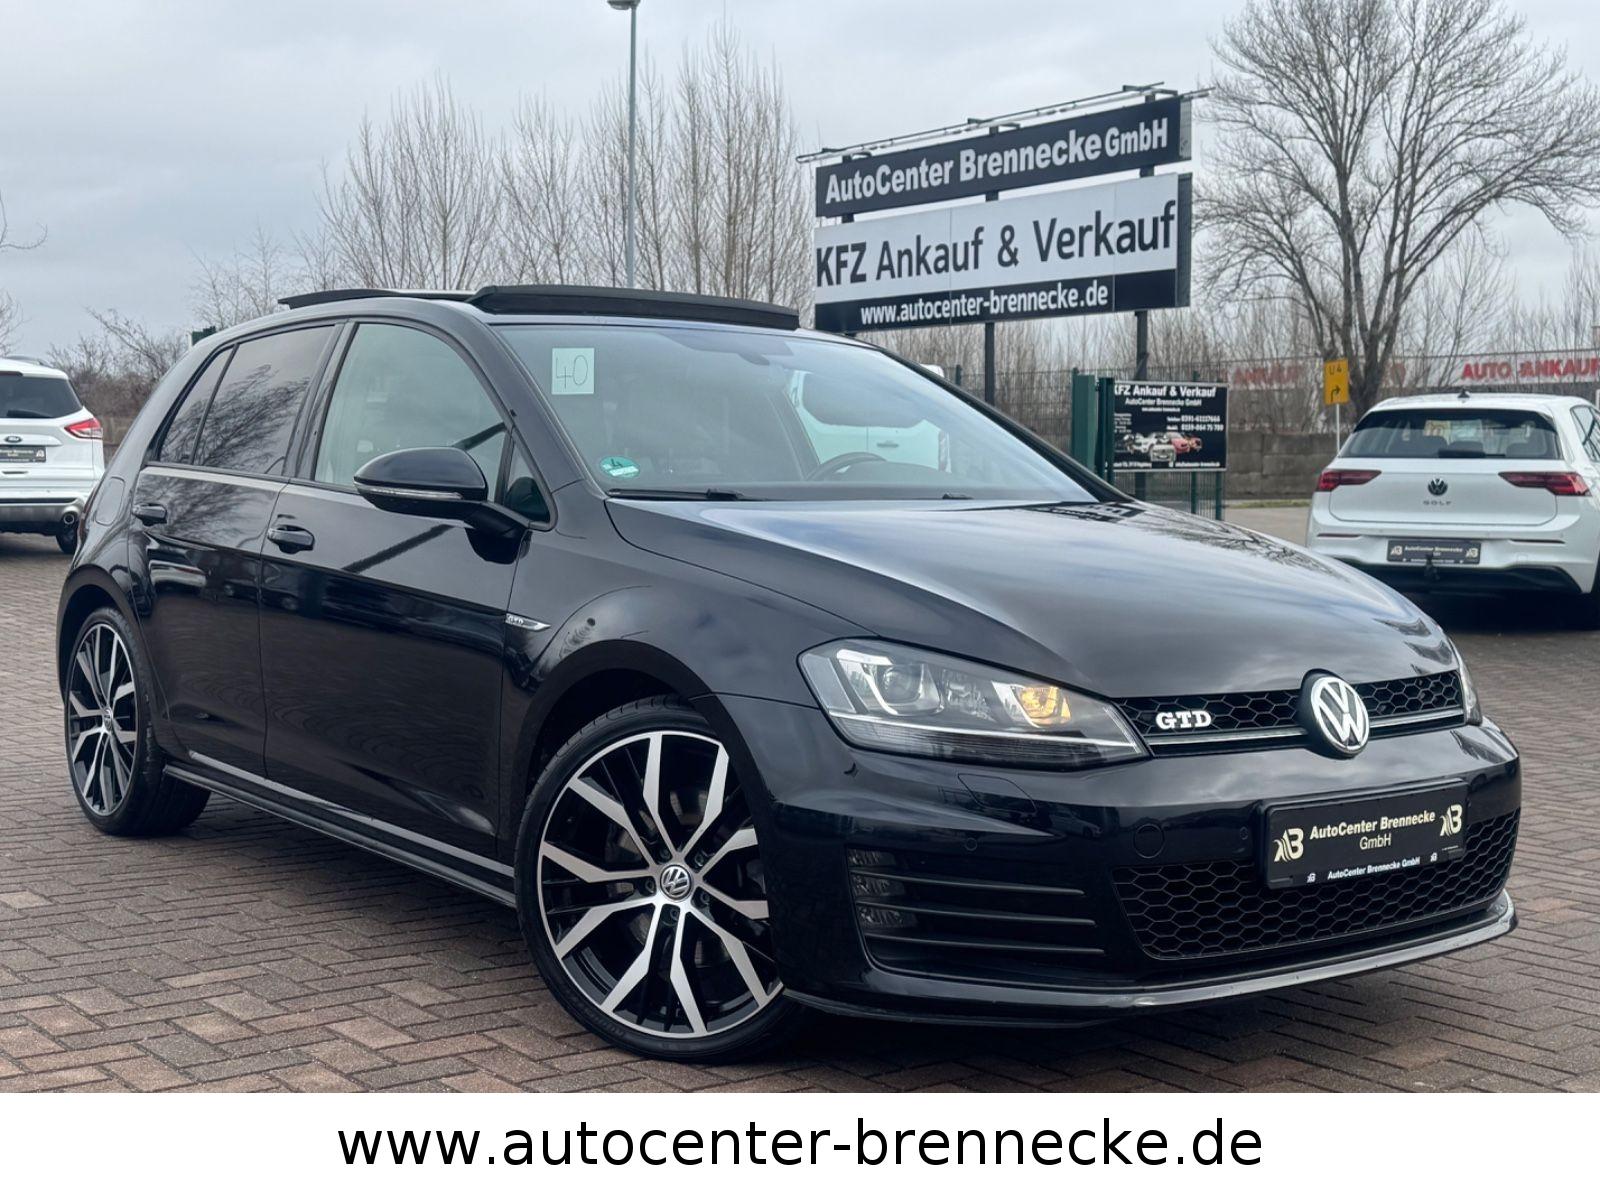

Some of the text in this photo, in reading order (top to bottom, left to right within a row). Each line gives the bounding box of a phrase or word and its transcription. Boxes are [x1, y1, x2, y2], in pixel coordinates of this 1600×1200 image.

[825, 117, 1169, 204] AutoCenter Brennecke GmbH
[816, 200, 1176, 287] KFZ Ankauf & Verkauf
[860, 280, 1108, 325] www.autocenter-brennecke.de
[555, 354, 588, 389] 40
[1462, 362, 1512, 379] AUTO
[1133, 386, 1167, 397] Ankauf
[1170, 387, 1177, 397] &
[1180, 387, 1217, 397] Verkauf
[1155, 709, 1212, 730] GTD
[1309, 820, 1378, 840] AutoCenter
[1380, 810, 1436, 830] Brennecke
[1359, 833, 1392, 851] GmbH
[1327, 866, 1367, 880] AutoCenter
[1367, 861, 1400, 874] Brennecke
[1401, 856, 1421, 868] GmbH
